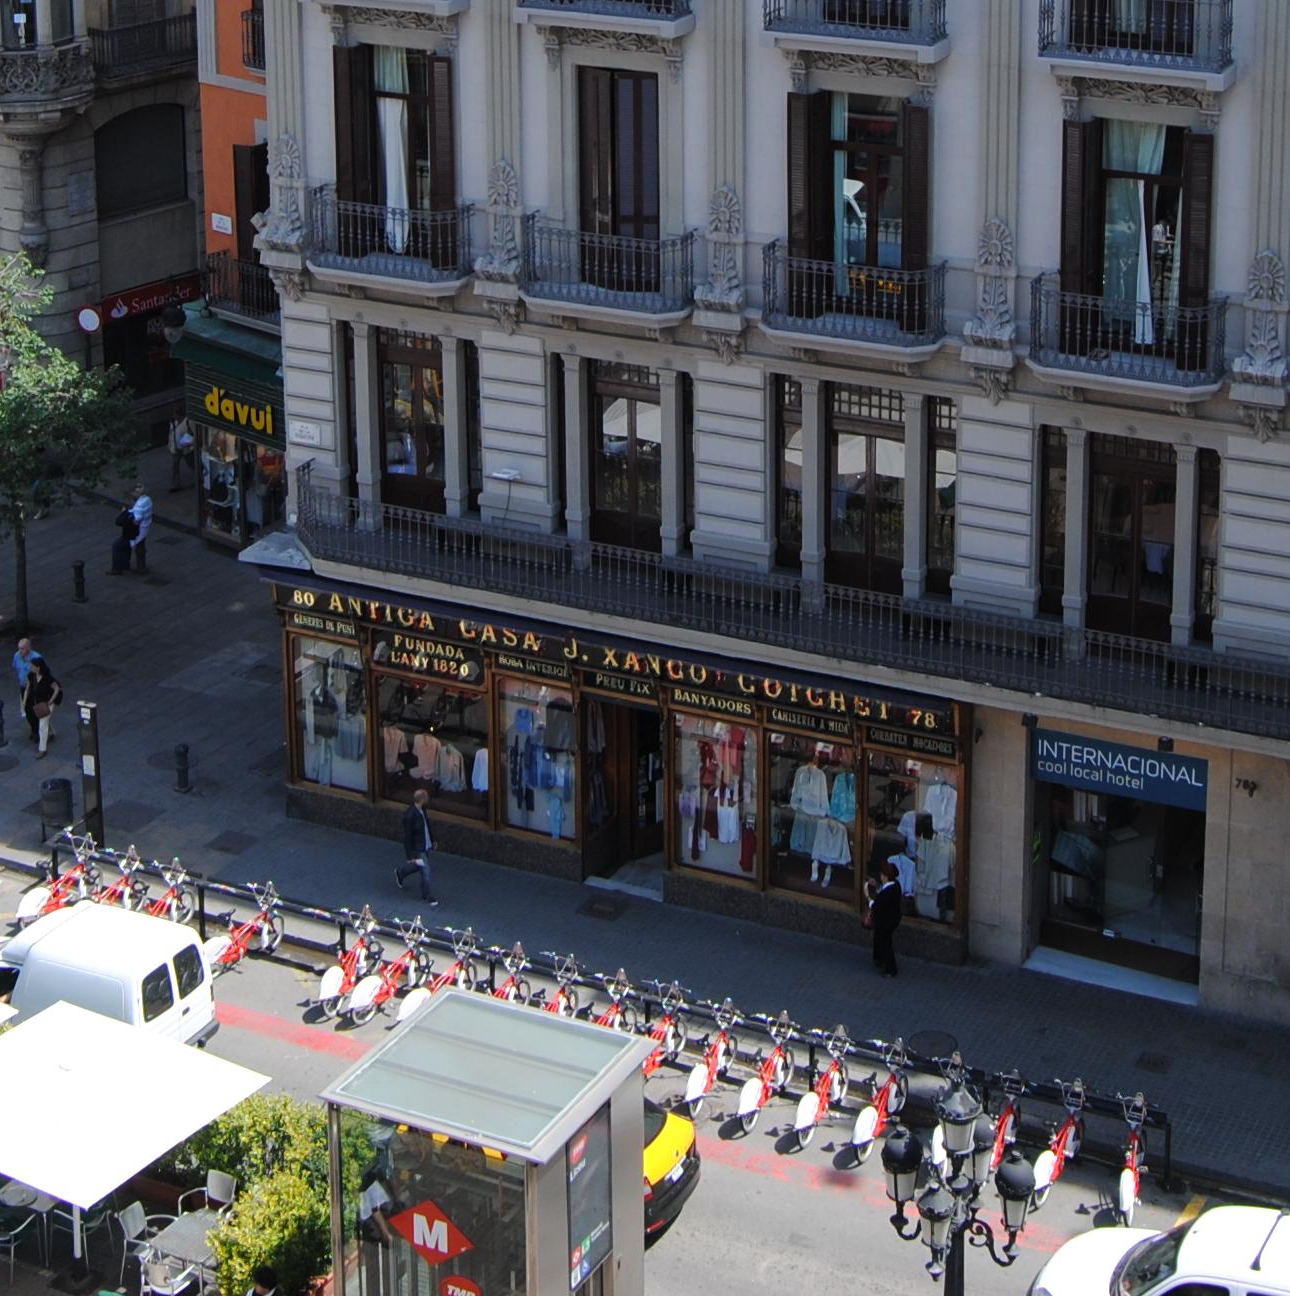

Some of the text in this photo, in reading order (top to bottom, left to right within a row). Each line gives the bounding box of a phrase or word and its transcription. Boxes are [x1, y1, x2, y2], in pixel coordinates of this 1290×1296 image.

[204, 386, 273, 435] d'avui
[293, 589, 315, 607] 80
[328, 592, 435, 631] ANTIGA
[459, 618, 541, 651] CASA
[563, 637, 589, 662] J.
[393, 634, 465, 660] FUNDADA
[390, 651, 470, 677] L'ANY 1820
[595, 672, 651, 695] PREU FIX
[674, 688, 752, 716] BANYADORS
[1037, 759, 1144, 790] cool local hotel
[1038, 739, 1204, 787] INTERNACIONAL
[413, 1213, 448, 1254] M
